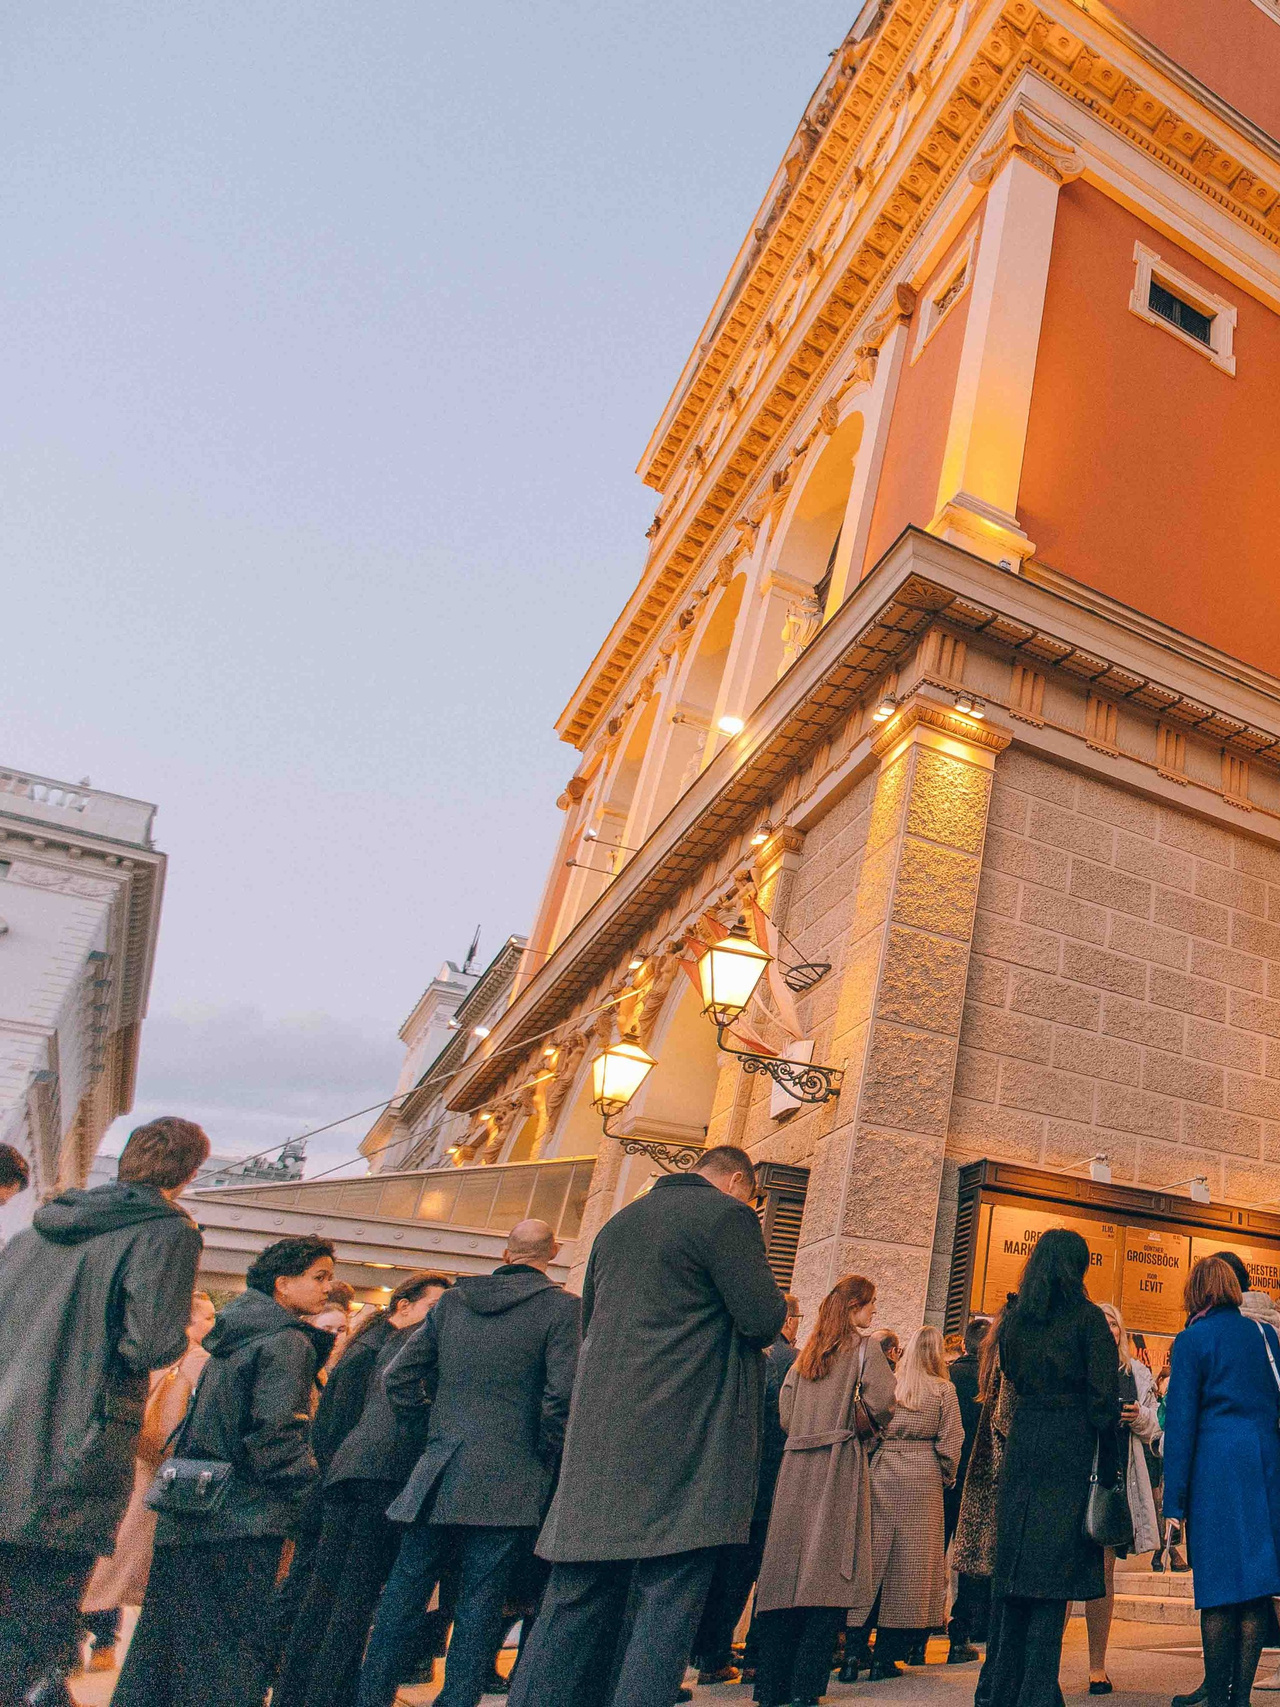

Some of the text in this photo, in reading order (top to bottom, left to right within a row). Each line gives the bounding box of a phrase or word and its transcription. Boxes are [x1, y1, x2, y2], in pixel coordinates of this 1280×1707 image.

[1003, 1239, 1035, 1256] MARK
[1127, 1250, 1180, 1269] GROISSBÖCK
[1246, 1262, 1278, 1278] CHESTER
[1139, 1279, 1164, 1294] LEVIT
